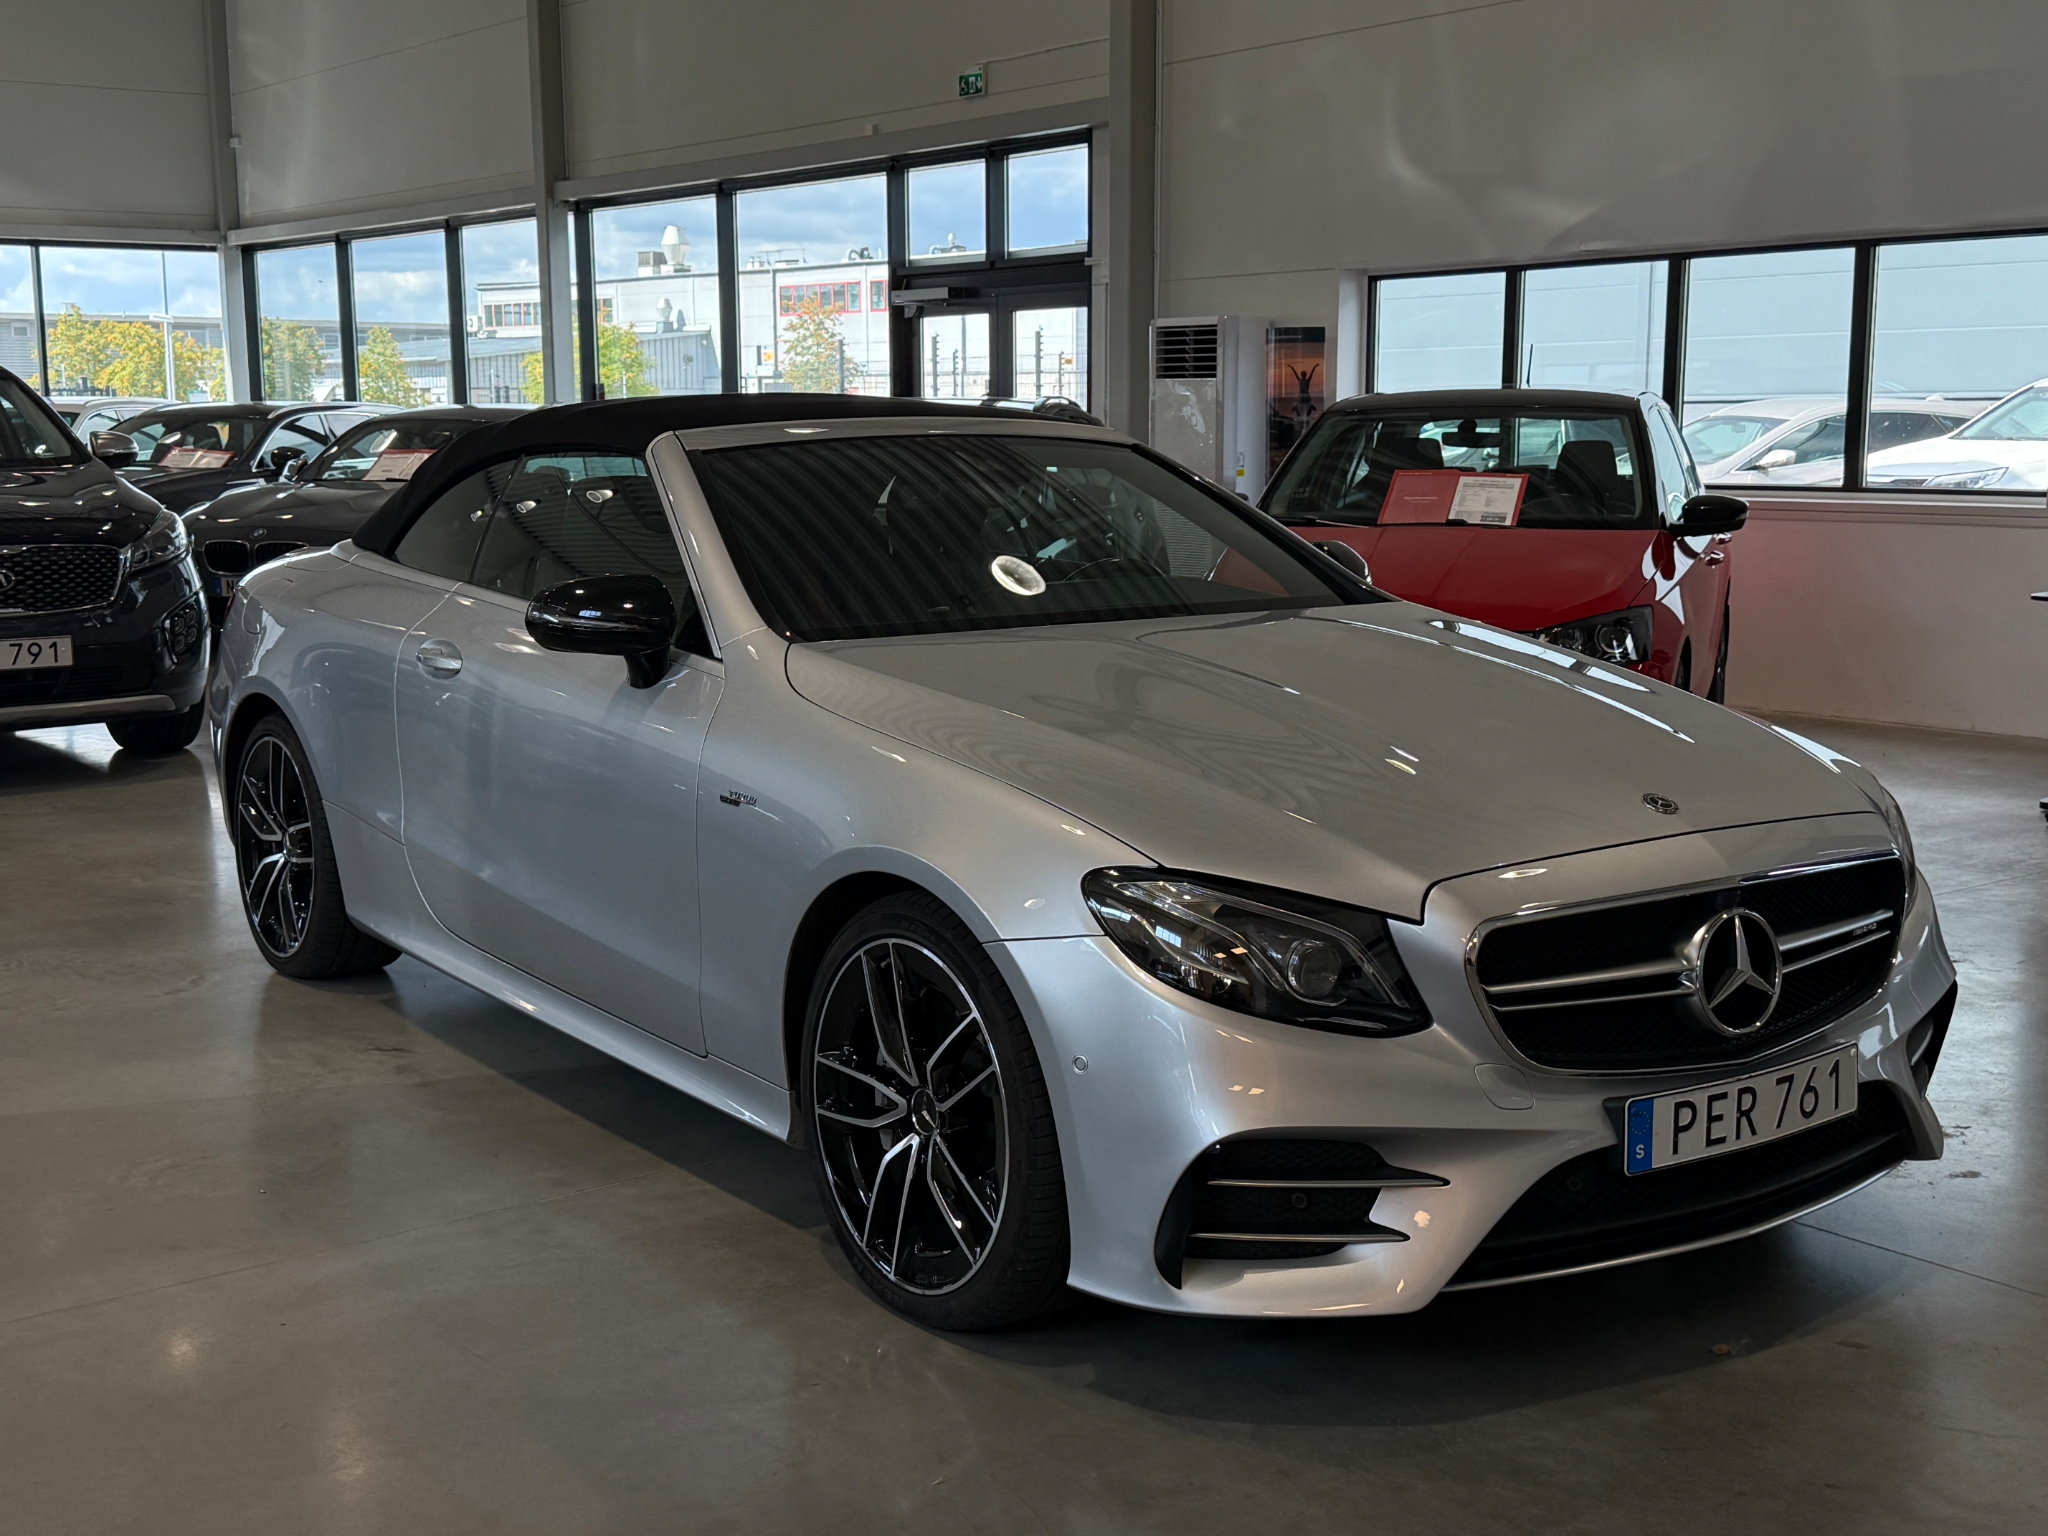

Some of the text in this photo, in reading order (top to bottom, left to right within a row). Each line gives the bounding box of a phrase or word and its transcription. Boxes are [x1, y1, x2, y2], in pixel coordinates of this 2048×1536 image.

[9, 641, 59, 666] 791
[1671, 1058, 1840, 1156] PER 761
[1635, 1144, 1645, 1159] S
